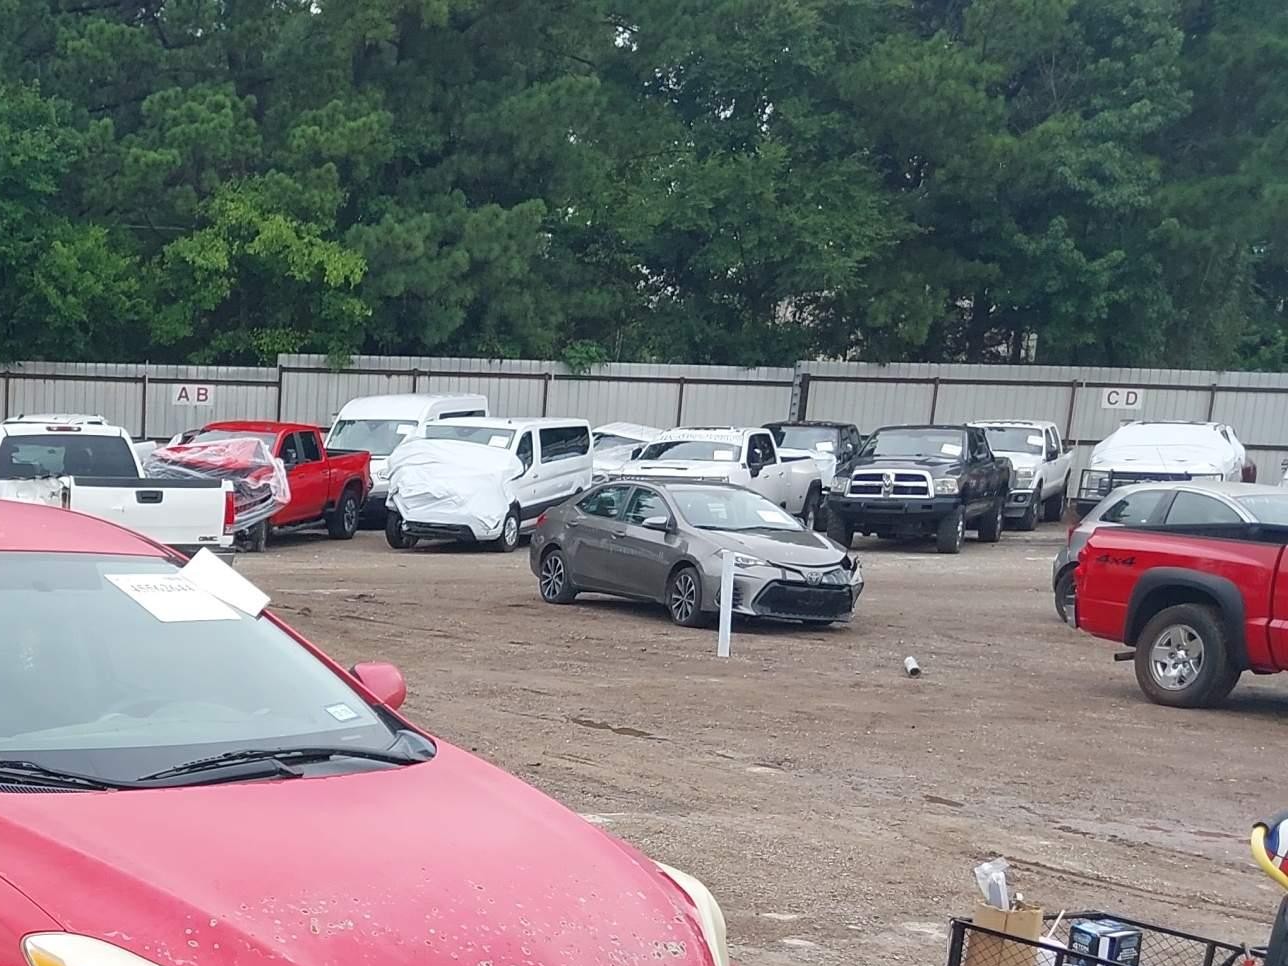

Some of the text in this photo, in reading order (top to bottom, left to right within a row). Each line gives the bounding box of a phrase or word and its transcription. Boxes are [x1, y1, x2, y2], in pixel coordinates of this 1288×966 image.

[177, 386, 209, 402] A B
[1107, 390, 1138, 405] C D
